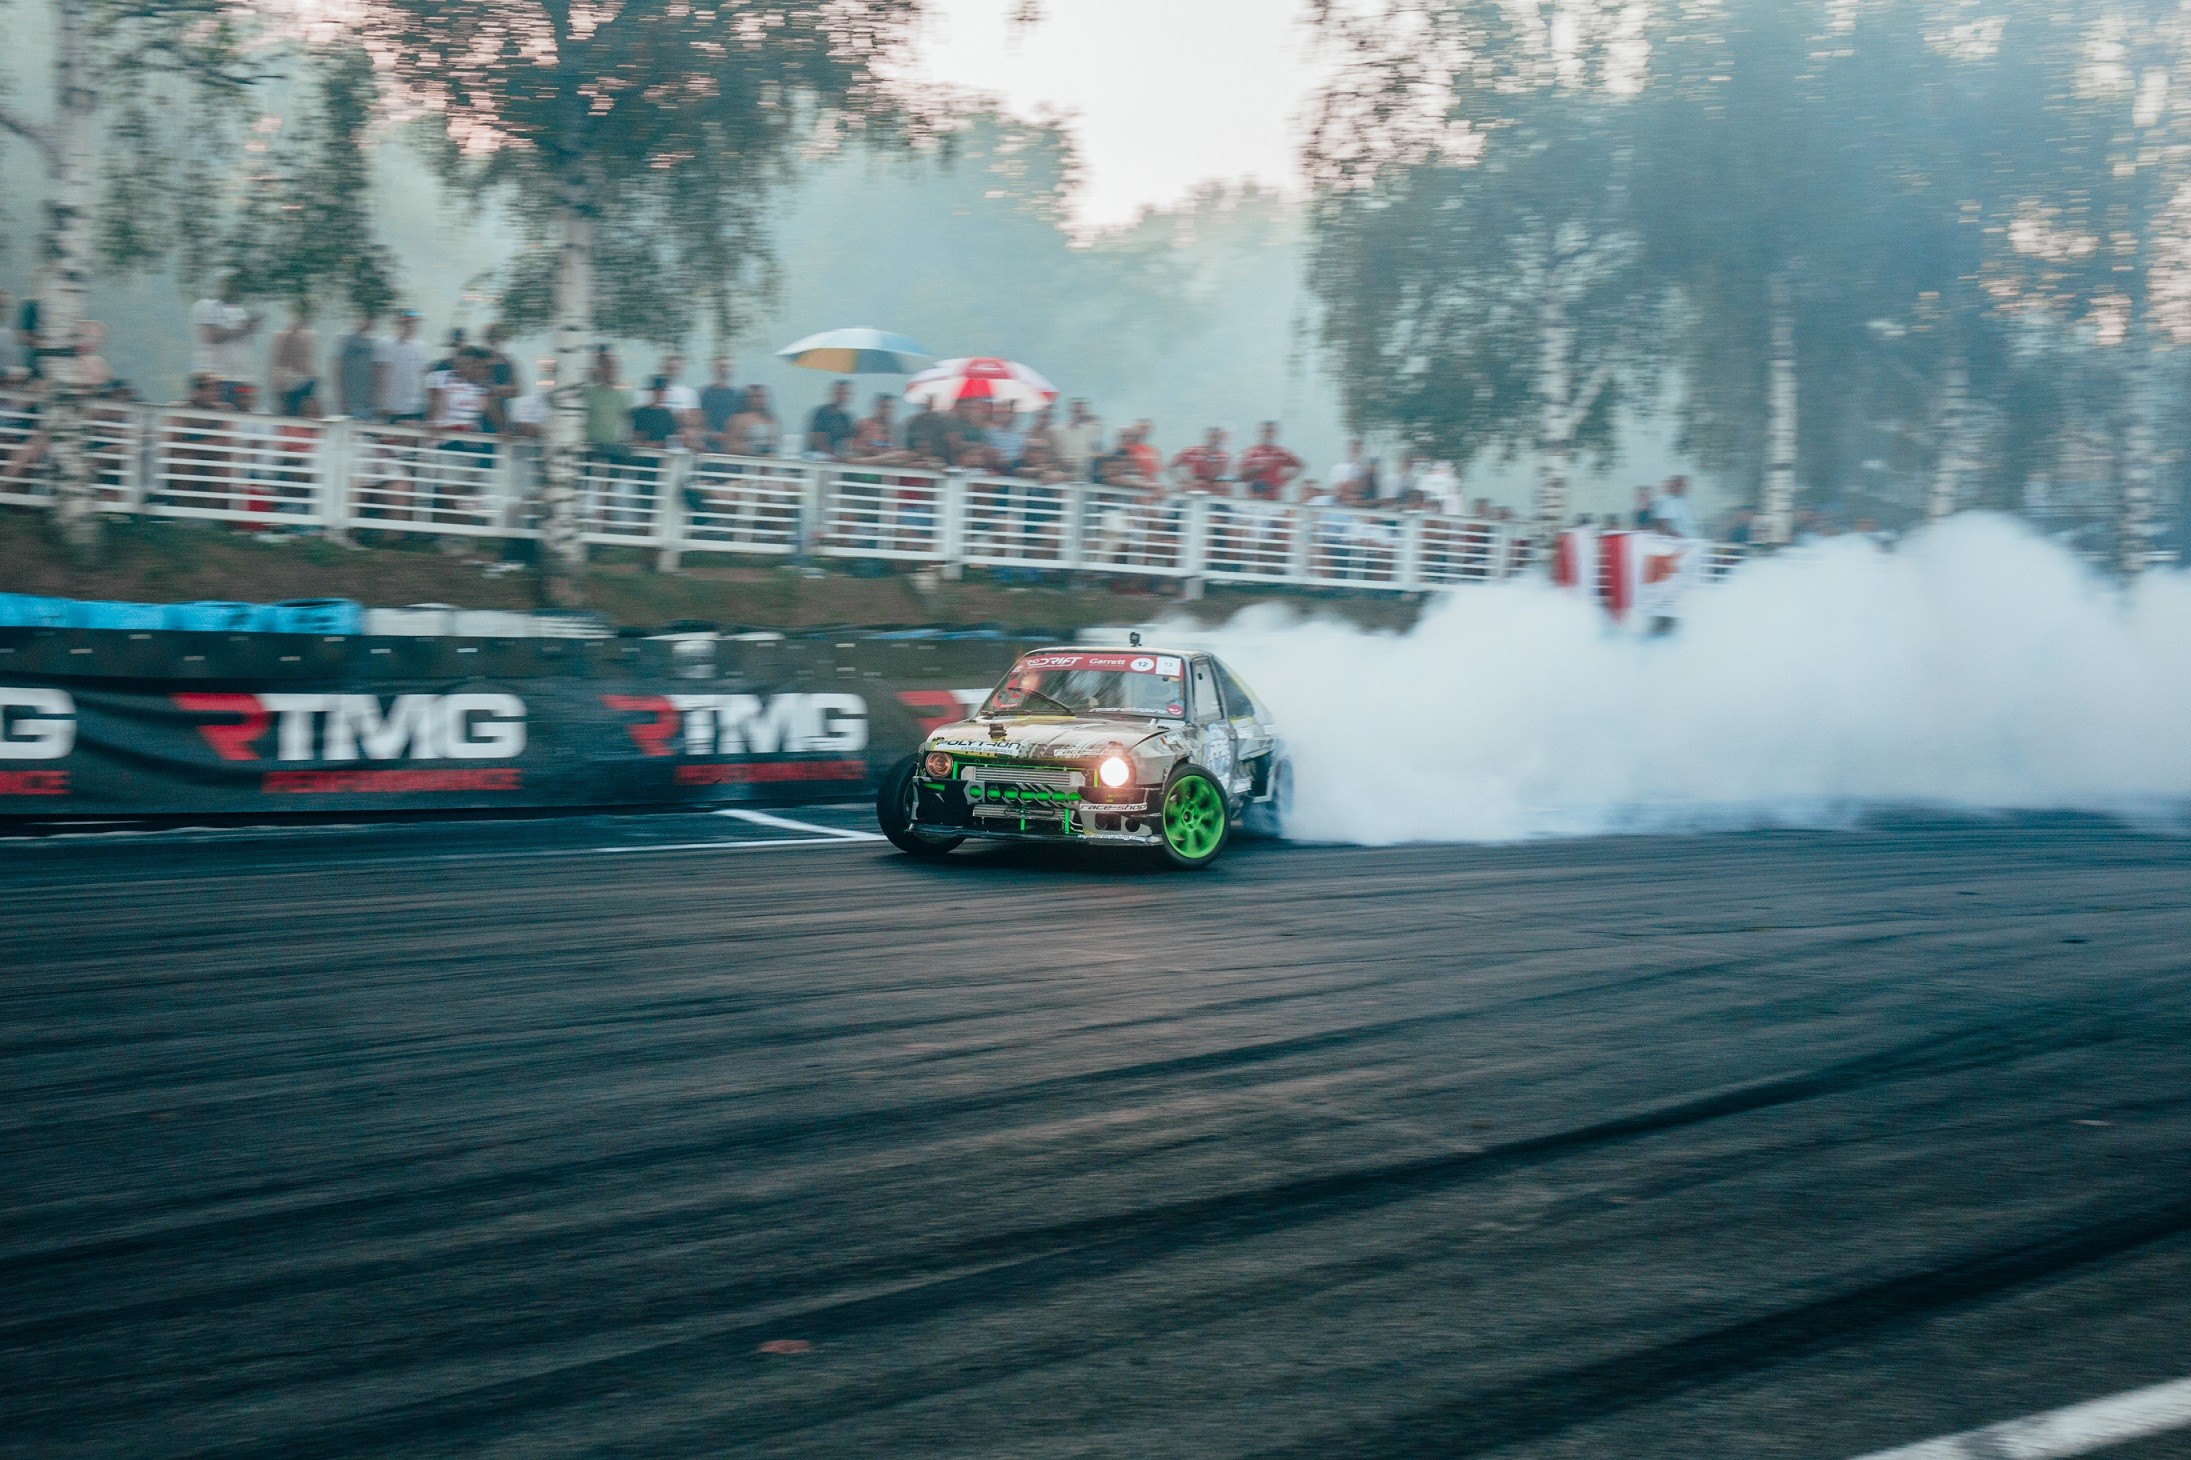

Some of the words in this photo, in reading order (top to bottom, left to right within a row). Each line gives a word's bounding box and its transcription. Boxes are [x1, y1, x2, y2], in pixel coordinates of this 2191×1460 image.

[170, 691, 527, 761] RTMG
[600, 692, 869, 756] RTMG
[1080, 803, 1147, 811] race-shop
